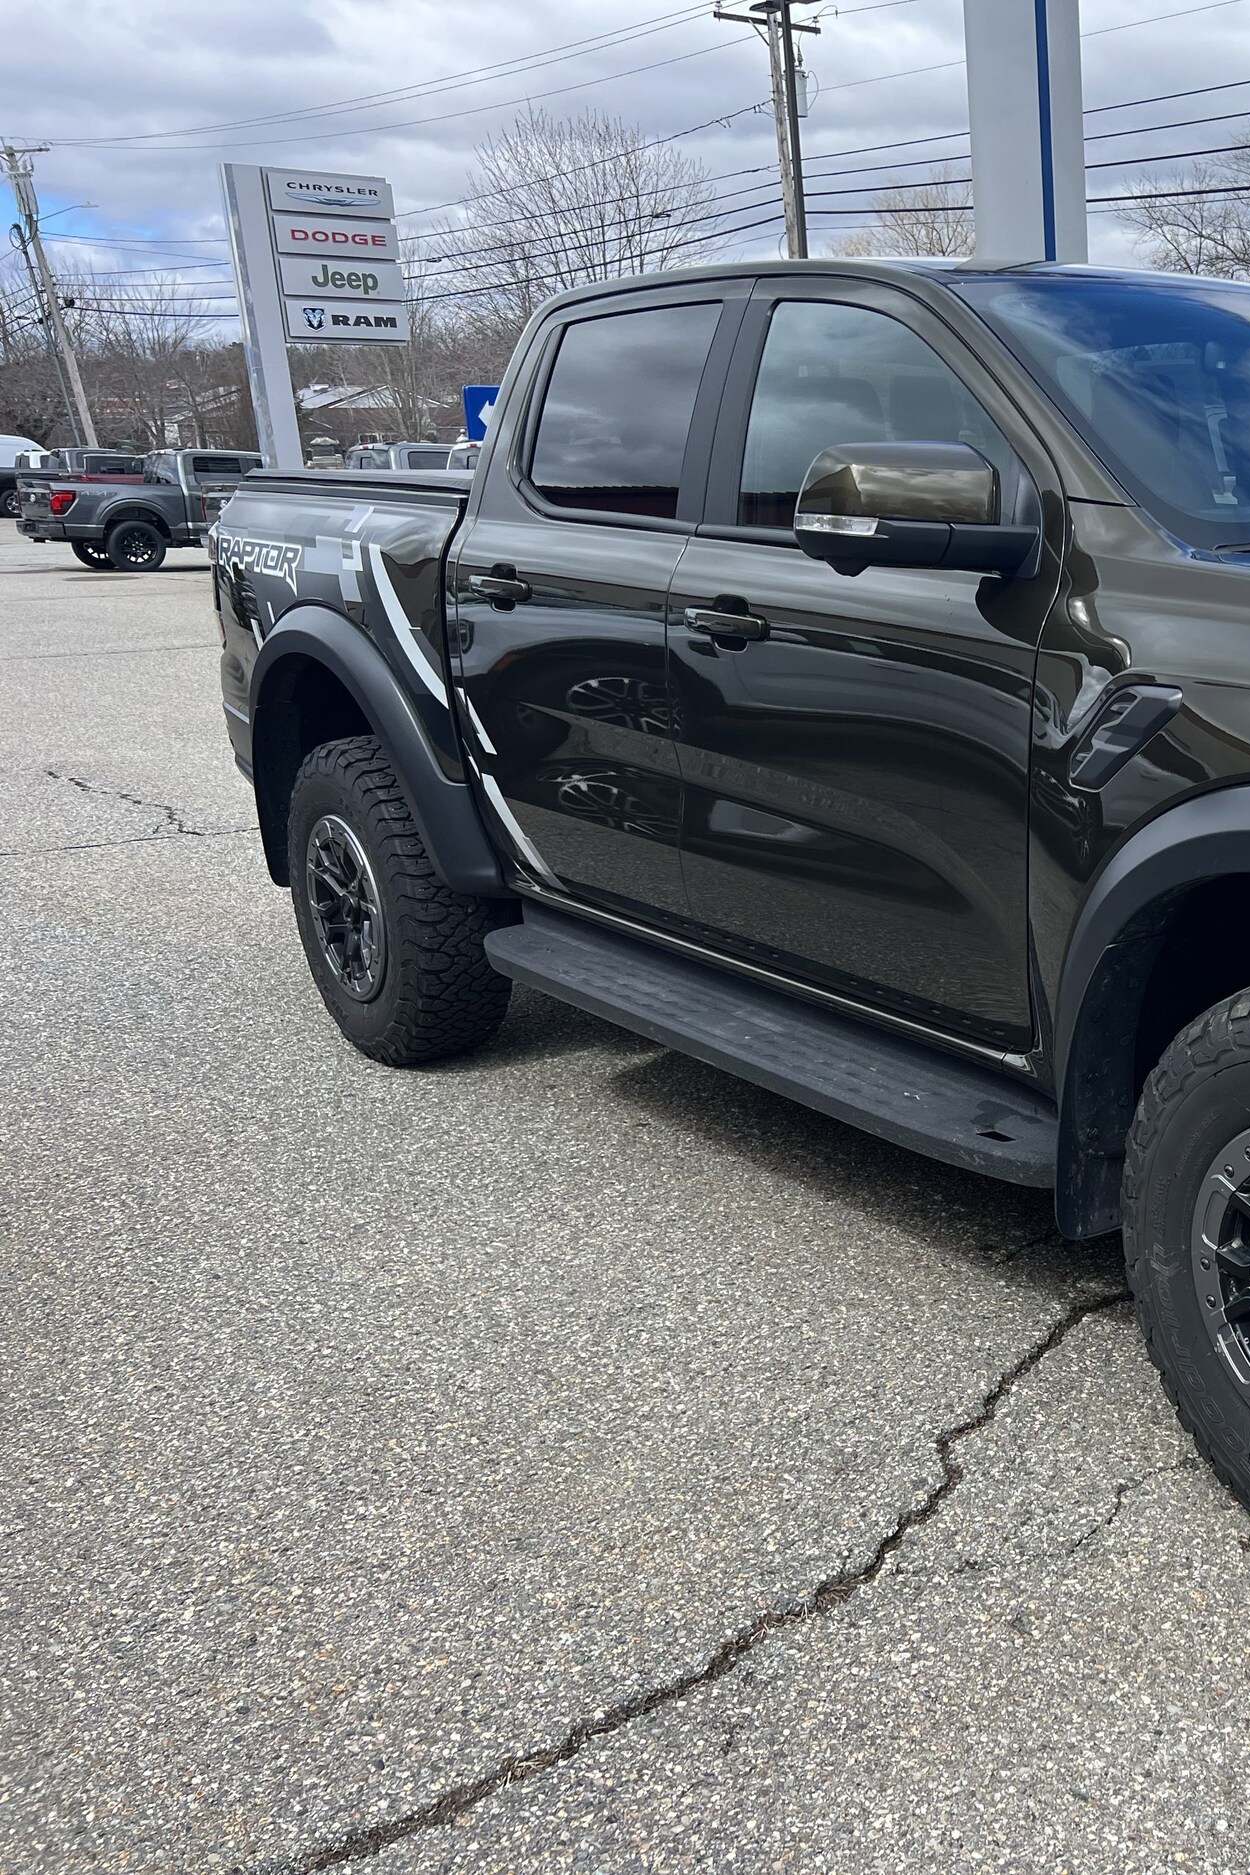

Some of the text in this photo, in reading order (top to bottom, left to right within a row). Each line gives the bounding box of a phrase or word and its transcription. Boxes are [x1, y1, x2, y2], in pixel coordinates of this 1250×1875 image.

[286, 182, 379, 197] CHRYSLER
[290, 229, 388, 247] DODGE
[311, 264, 379, 295] Jeep
[330, 314, 398, 328] RAM
[218, 534, 303, 597] RAPTOR
